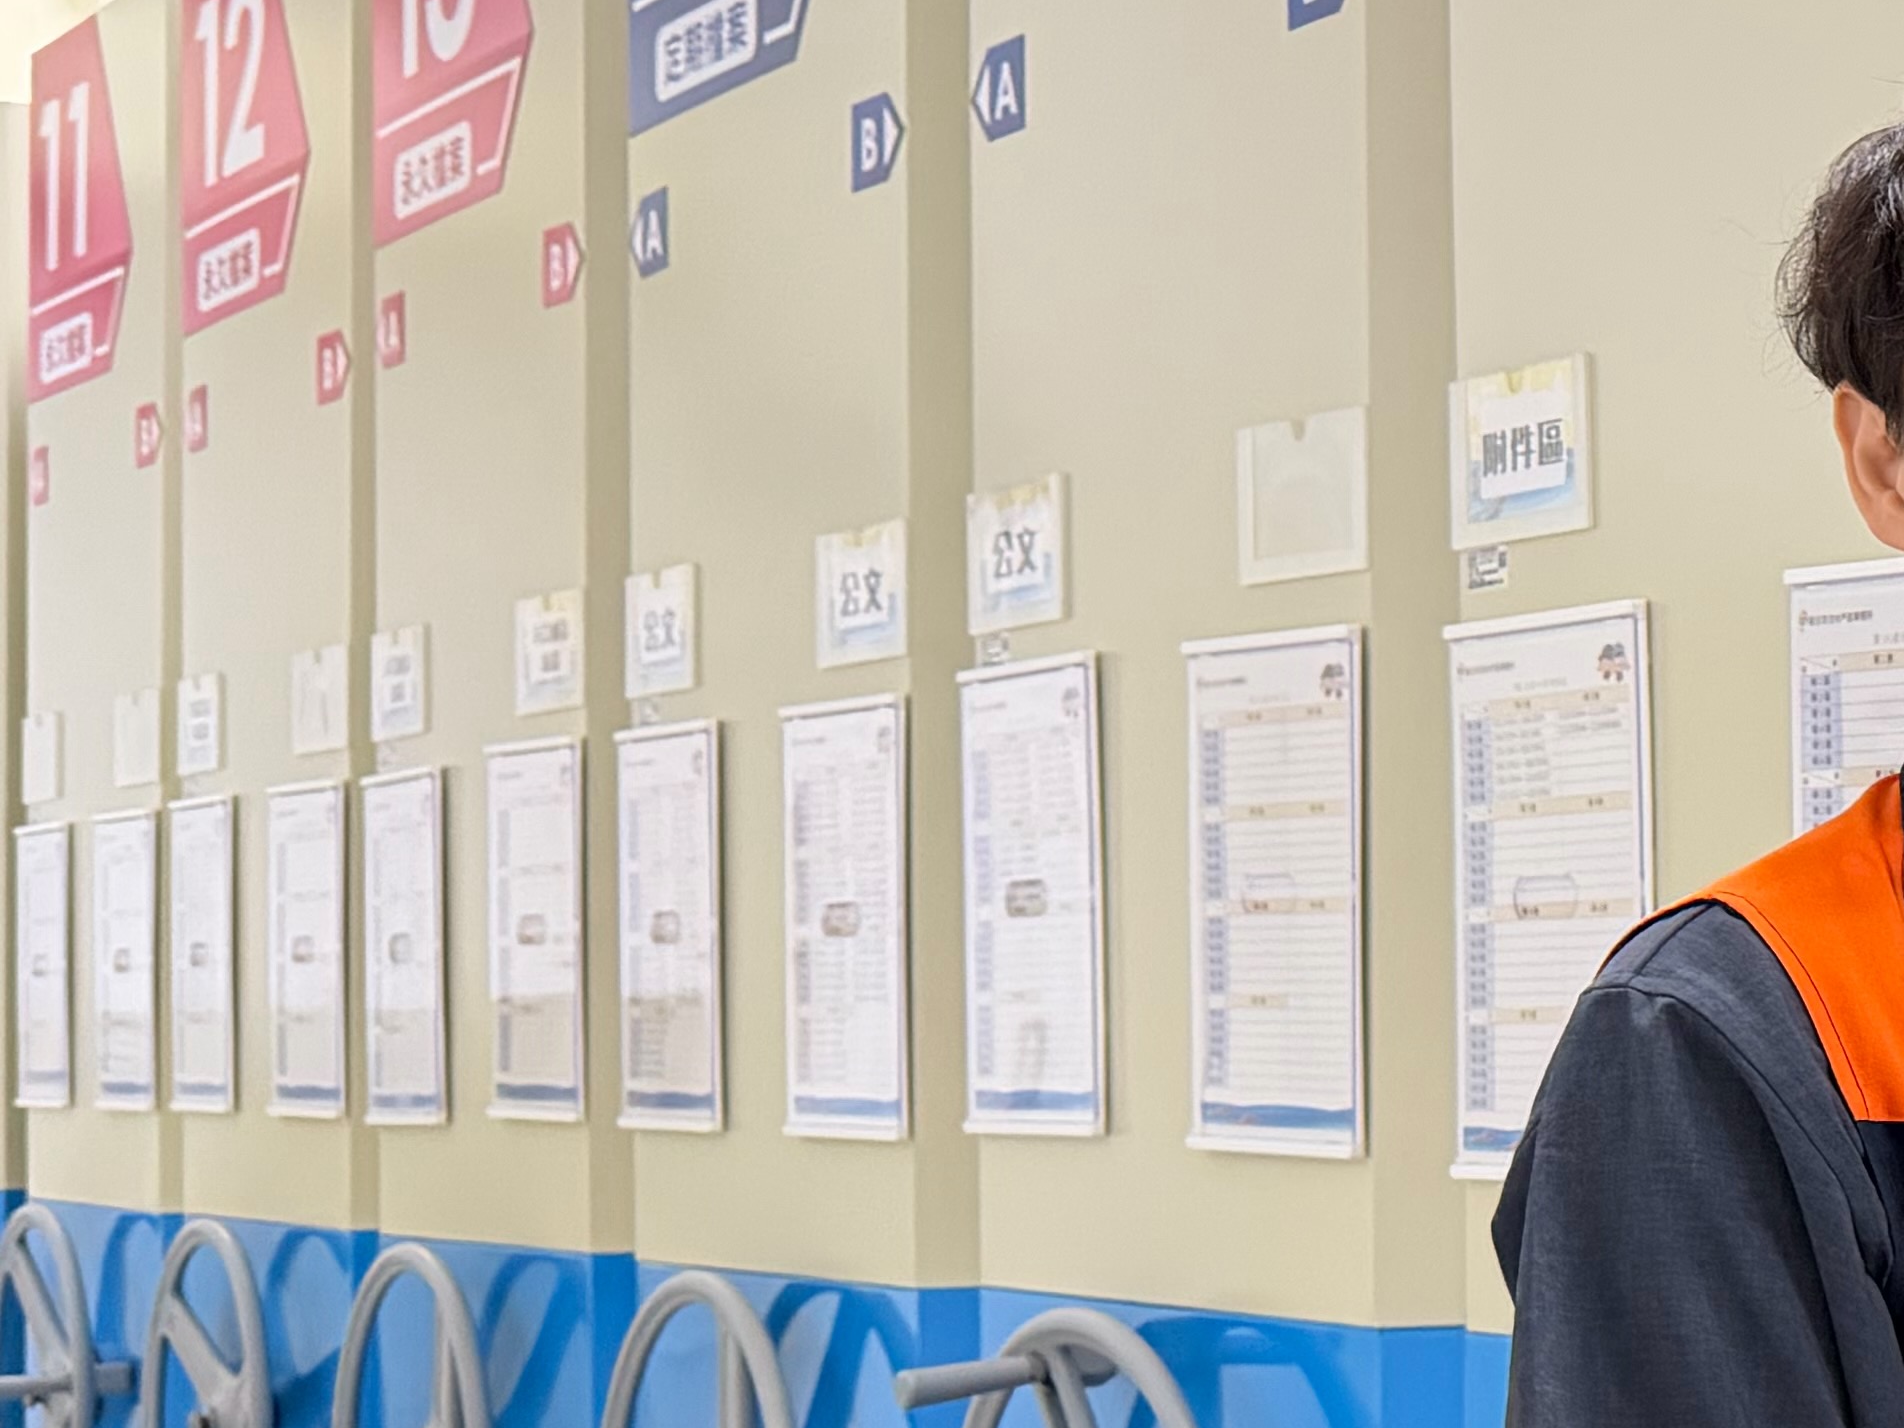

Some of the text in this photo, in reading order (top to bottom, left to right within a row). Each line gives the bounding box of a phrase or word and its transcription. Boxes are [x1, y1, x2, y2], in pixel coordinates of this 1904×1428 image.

[995, 62, 1018, 120] A
[861, 118, 877, 172] B
[39, 81, 89, 270] 11
[646, 210, 663, 260] A
[1482, 418, 1565, 478] 附件區
[993, 527, 1038, 579] 公文
[840, 567, 883, 616] 公文
